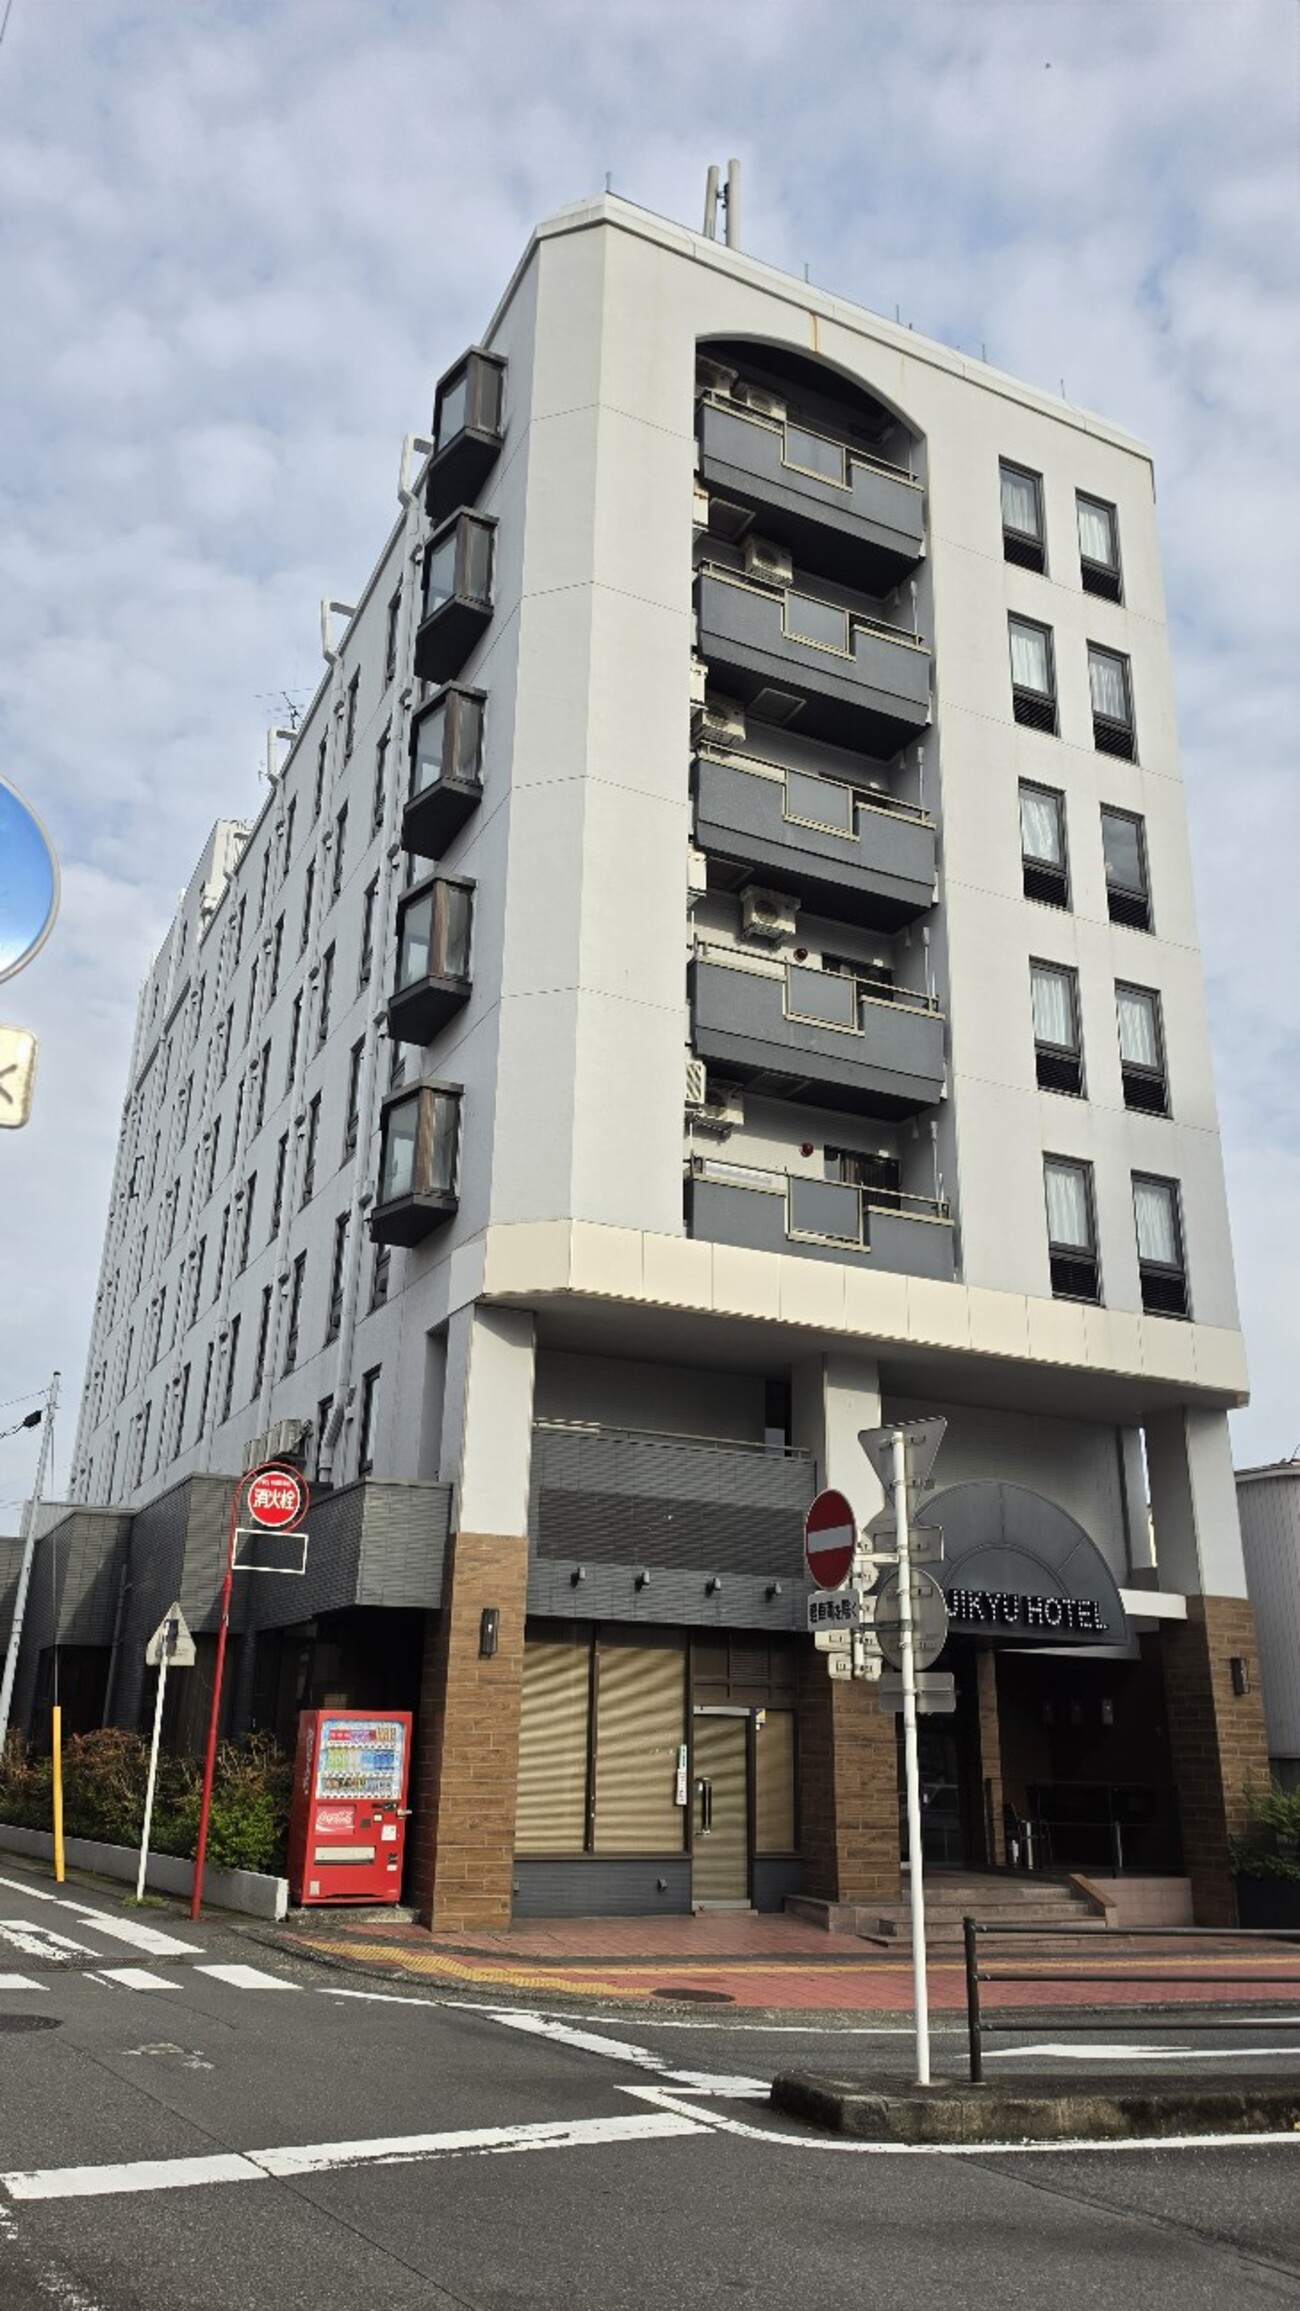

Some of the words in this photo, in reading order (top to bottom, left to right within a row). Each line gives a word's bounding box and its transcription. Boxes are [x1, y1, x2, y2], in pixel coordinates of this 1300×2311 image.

[253, 1488, 296, 1510] 消火栓
[947, 1588, 1019, 1623] JIKYU
[1024, 1596, 1109, 1631] HOTEL
